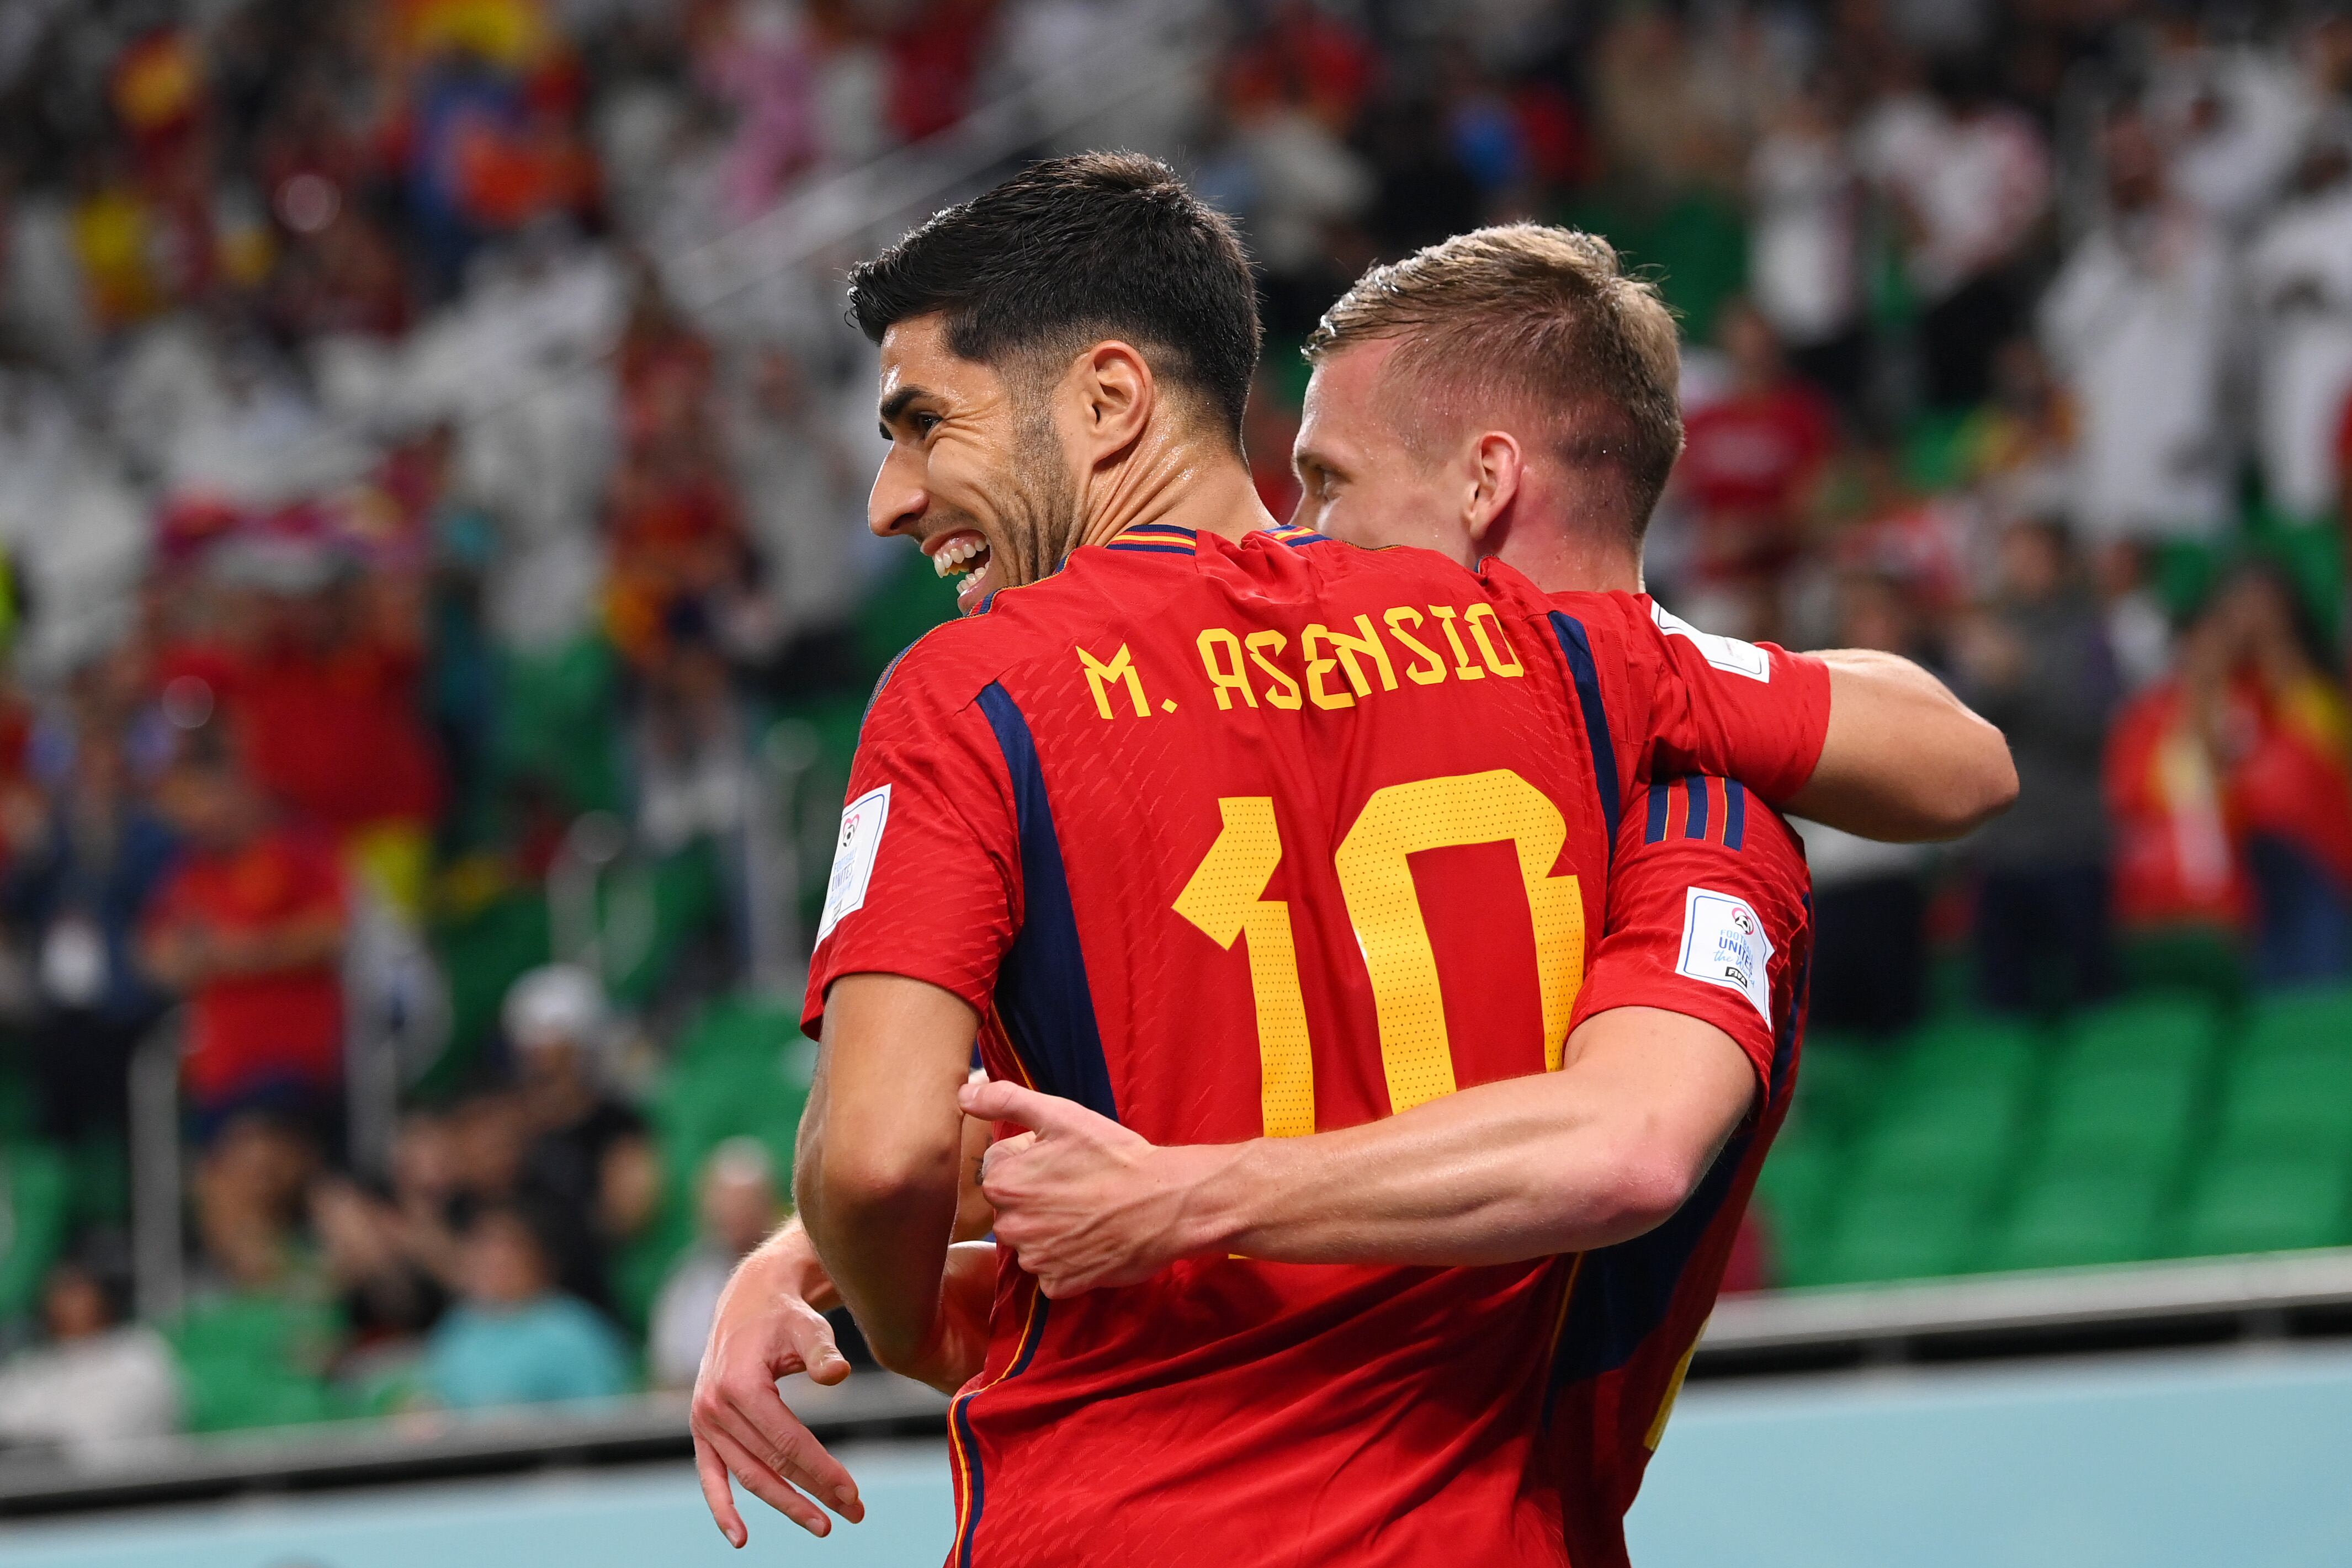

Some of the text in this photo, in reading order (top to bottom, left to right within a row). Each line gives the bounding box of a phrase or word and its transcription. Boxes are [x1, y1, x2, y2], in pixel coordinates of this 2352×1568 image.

[1076, 603, 1524, 720] M. ASENSIO
[1171, 769, 1585, 1138] 10
[1713, 950, 1734, 961] the
[1719, 937, 1753, 975] UNITES
[1727, 968, 1746, 985] FIFA
